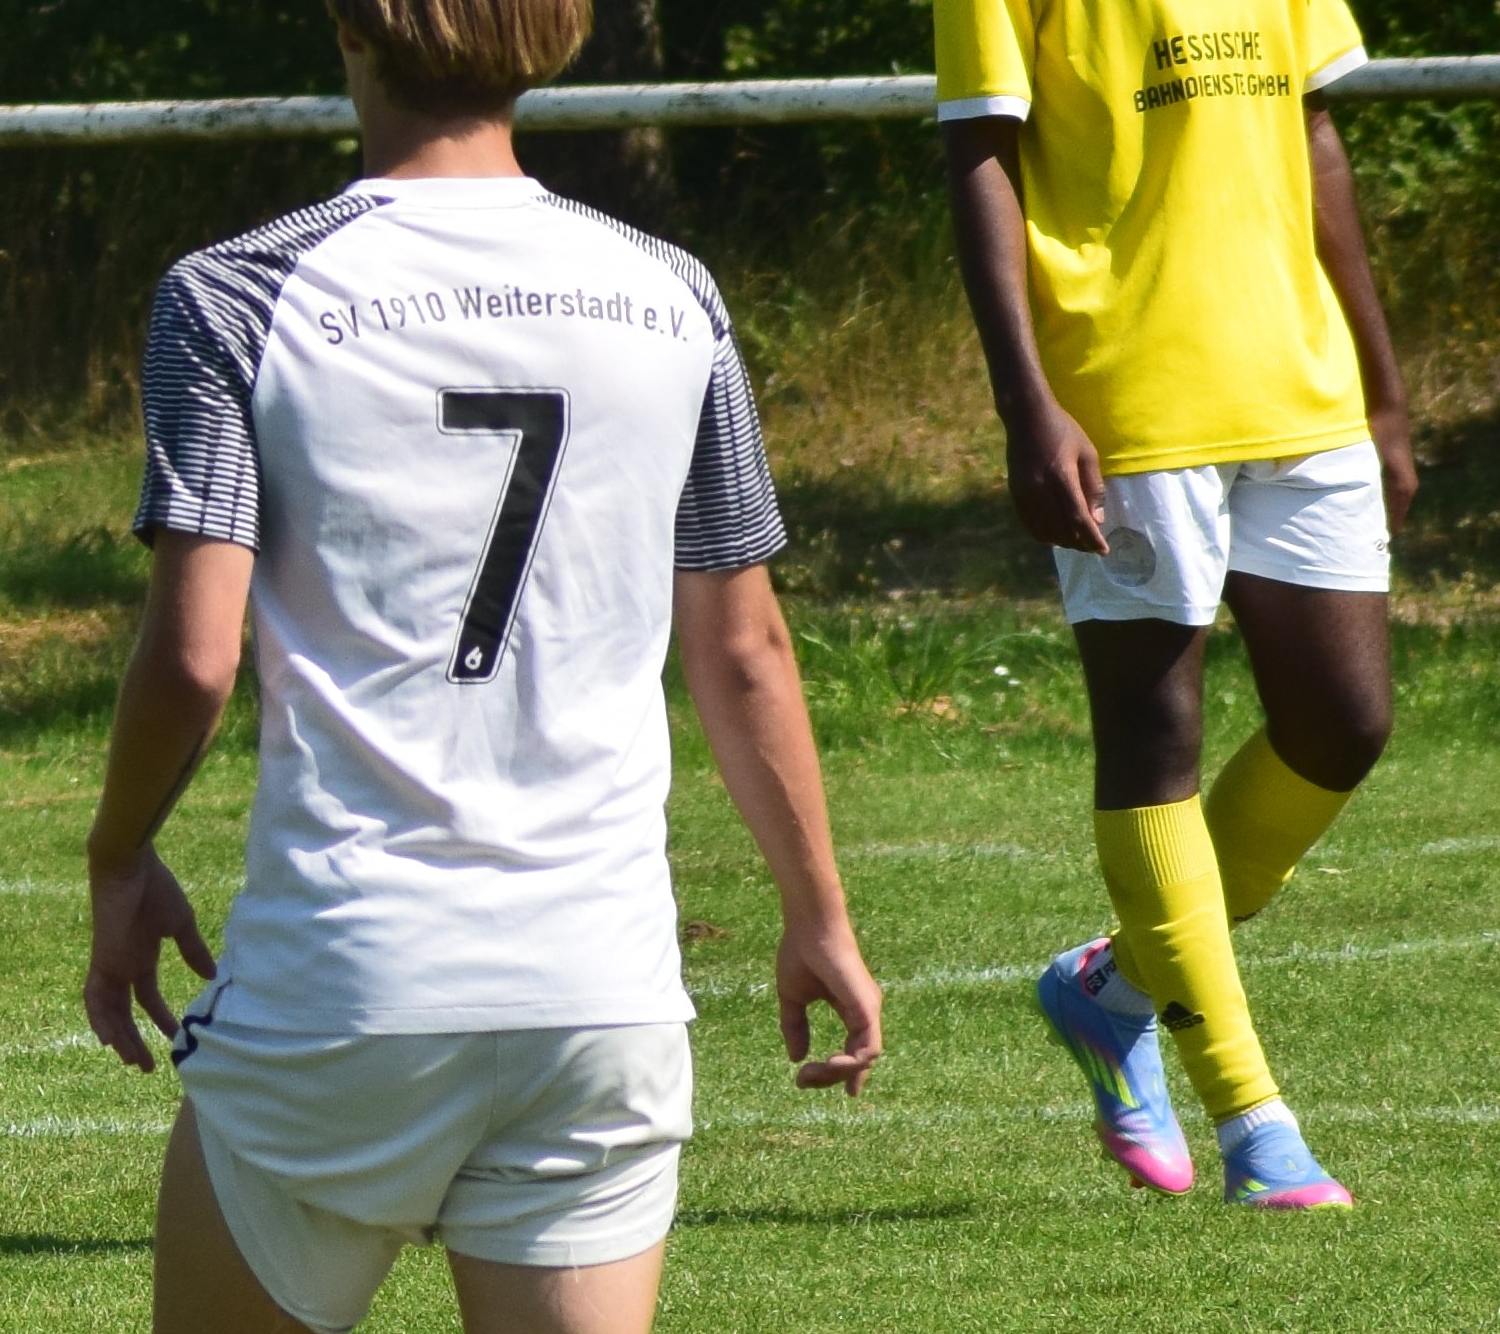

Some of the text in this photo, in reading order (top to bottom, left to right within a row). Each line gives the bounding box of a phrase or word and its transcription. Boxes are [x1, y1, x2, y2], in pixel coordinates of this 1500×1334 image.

[1153, 31, 1262, 70] HESSISCHE
[1133, 73, 1290, 113] BAHNDIENSTE GMBH
[319, 284, 688, 345] SV 1910 Weiterstadt e.V.
[436, 387, 570, 684] 7
